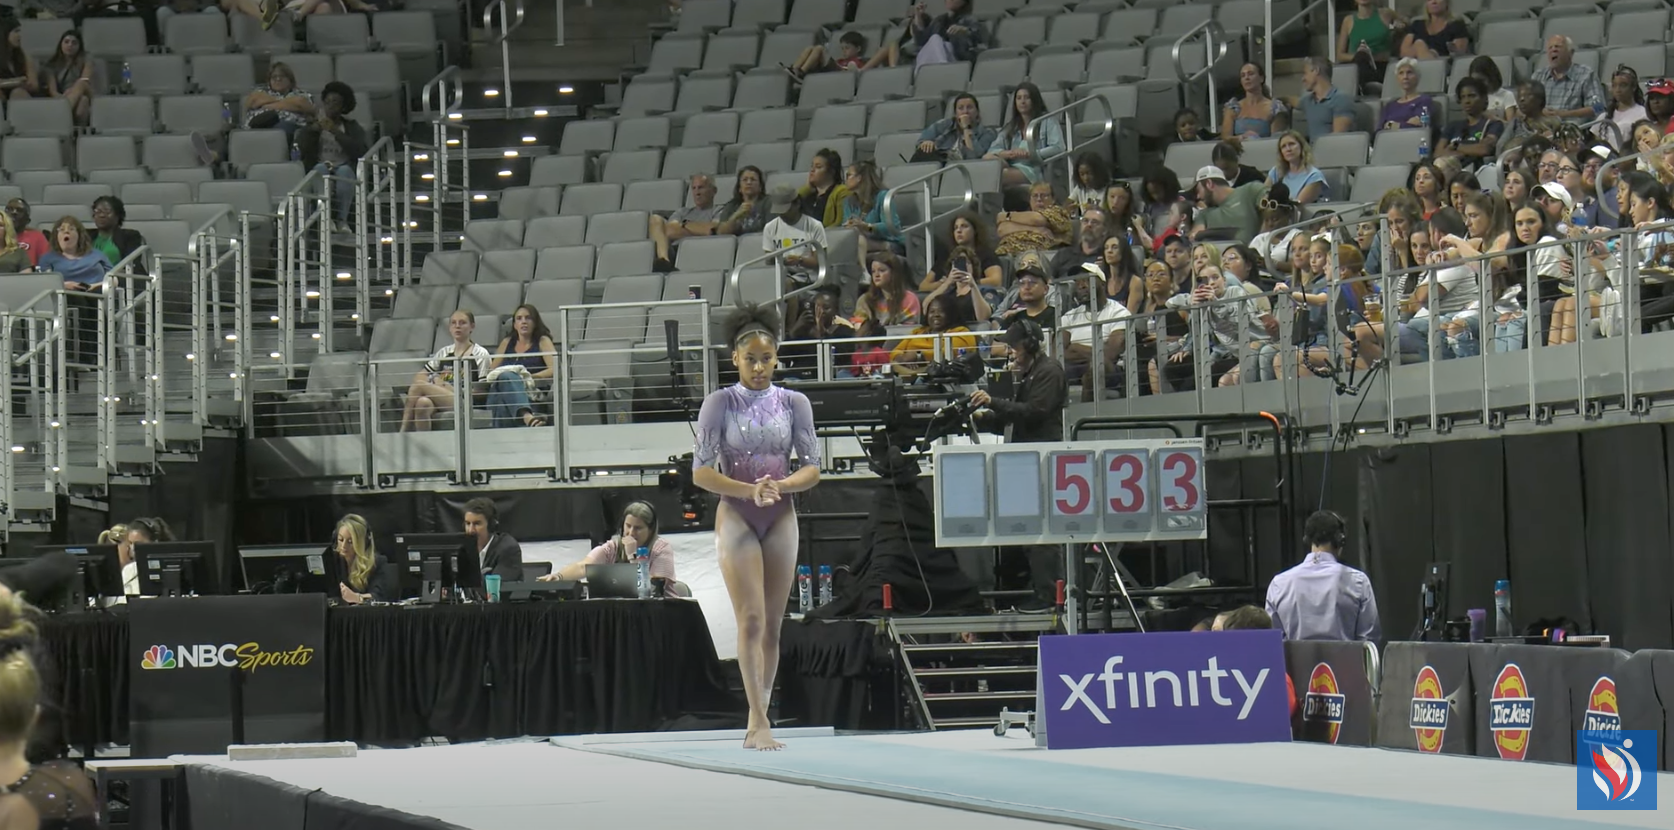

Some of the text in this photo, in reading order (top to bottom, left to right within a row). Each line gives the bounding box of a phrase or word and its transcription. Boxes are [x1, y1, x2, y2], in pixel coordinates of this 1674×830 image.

[800, 581, 809, 607] core
[177, 642, 314, 674] NBC Sports
[1058, 655, 1271, 724] xfinity
[1412, 703, 1446, 724] Dickies
[1492, 703, 1532, 725] Dickies
